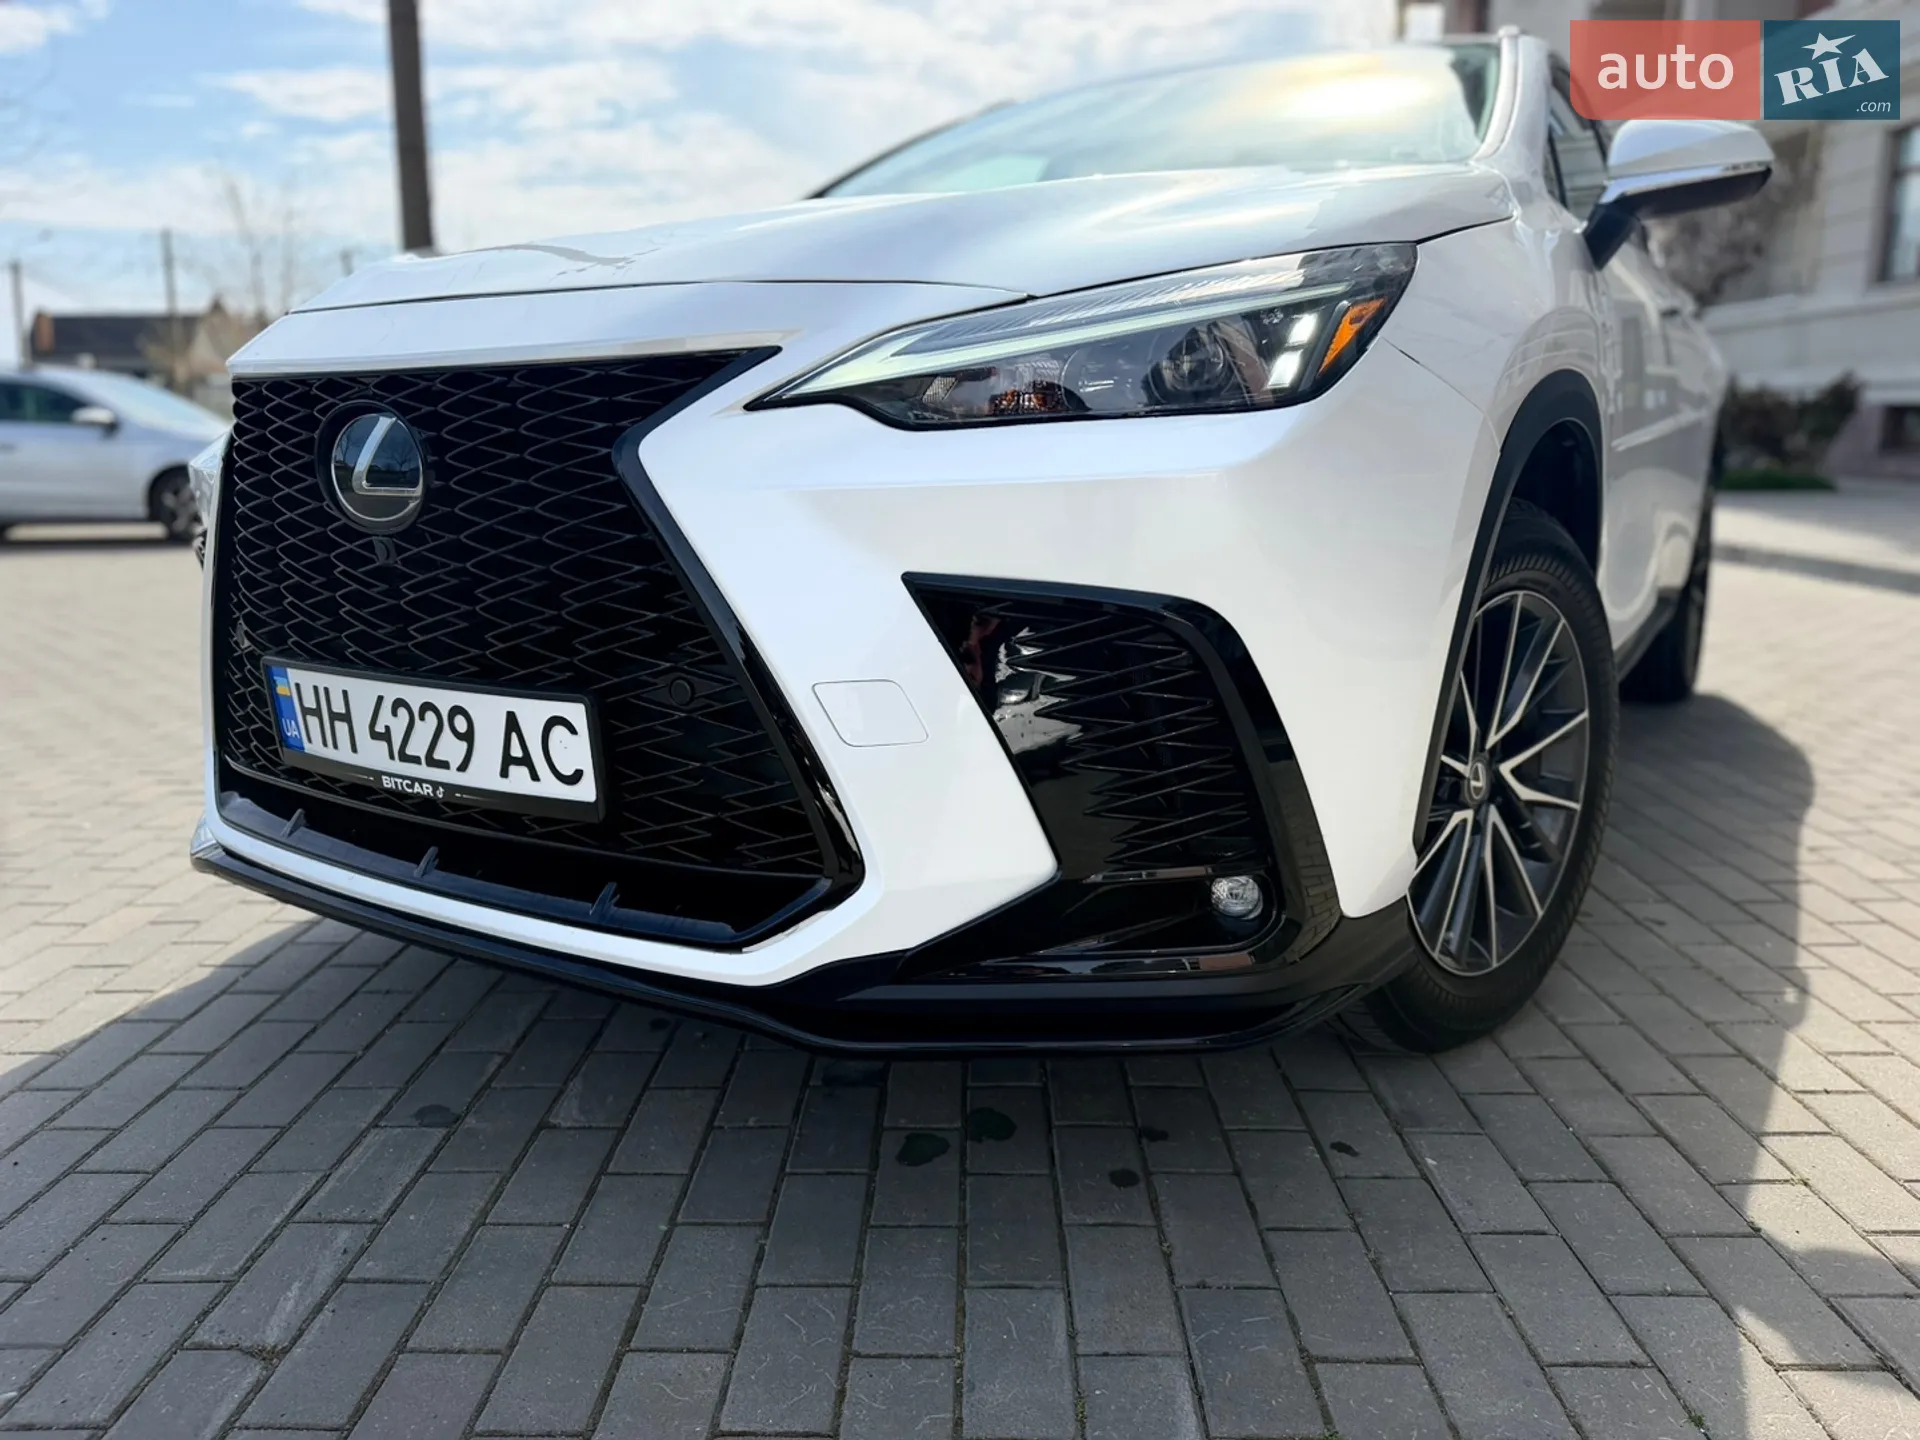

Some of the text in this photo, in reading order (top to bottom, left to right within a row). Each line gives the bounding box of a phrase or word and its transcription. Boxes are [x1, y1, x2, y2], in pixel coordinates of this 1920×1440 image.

[281, 717, 301, 739] UA
[295, 682, 585, 787] HH 4229 AC
[381, 774, 434, 797] BITCAR
